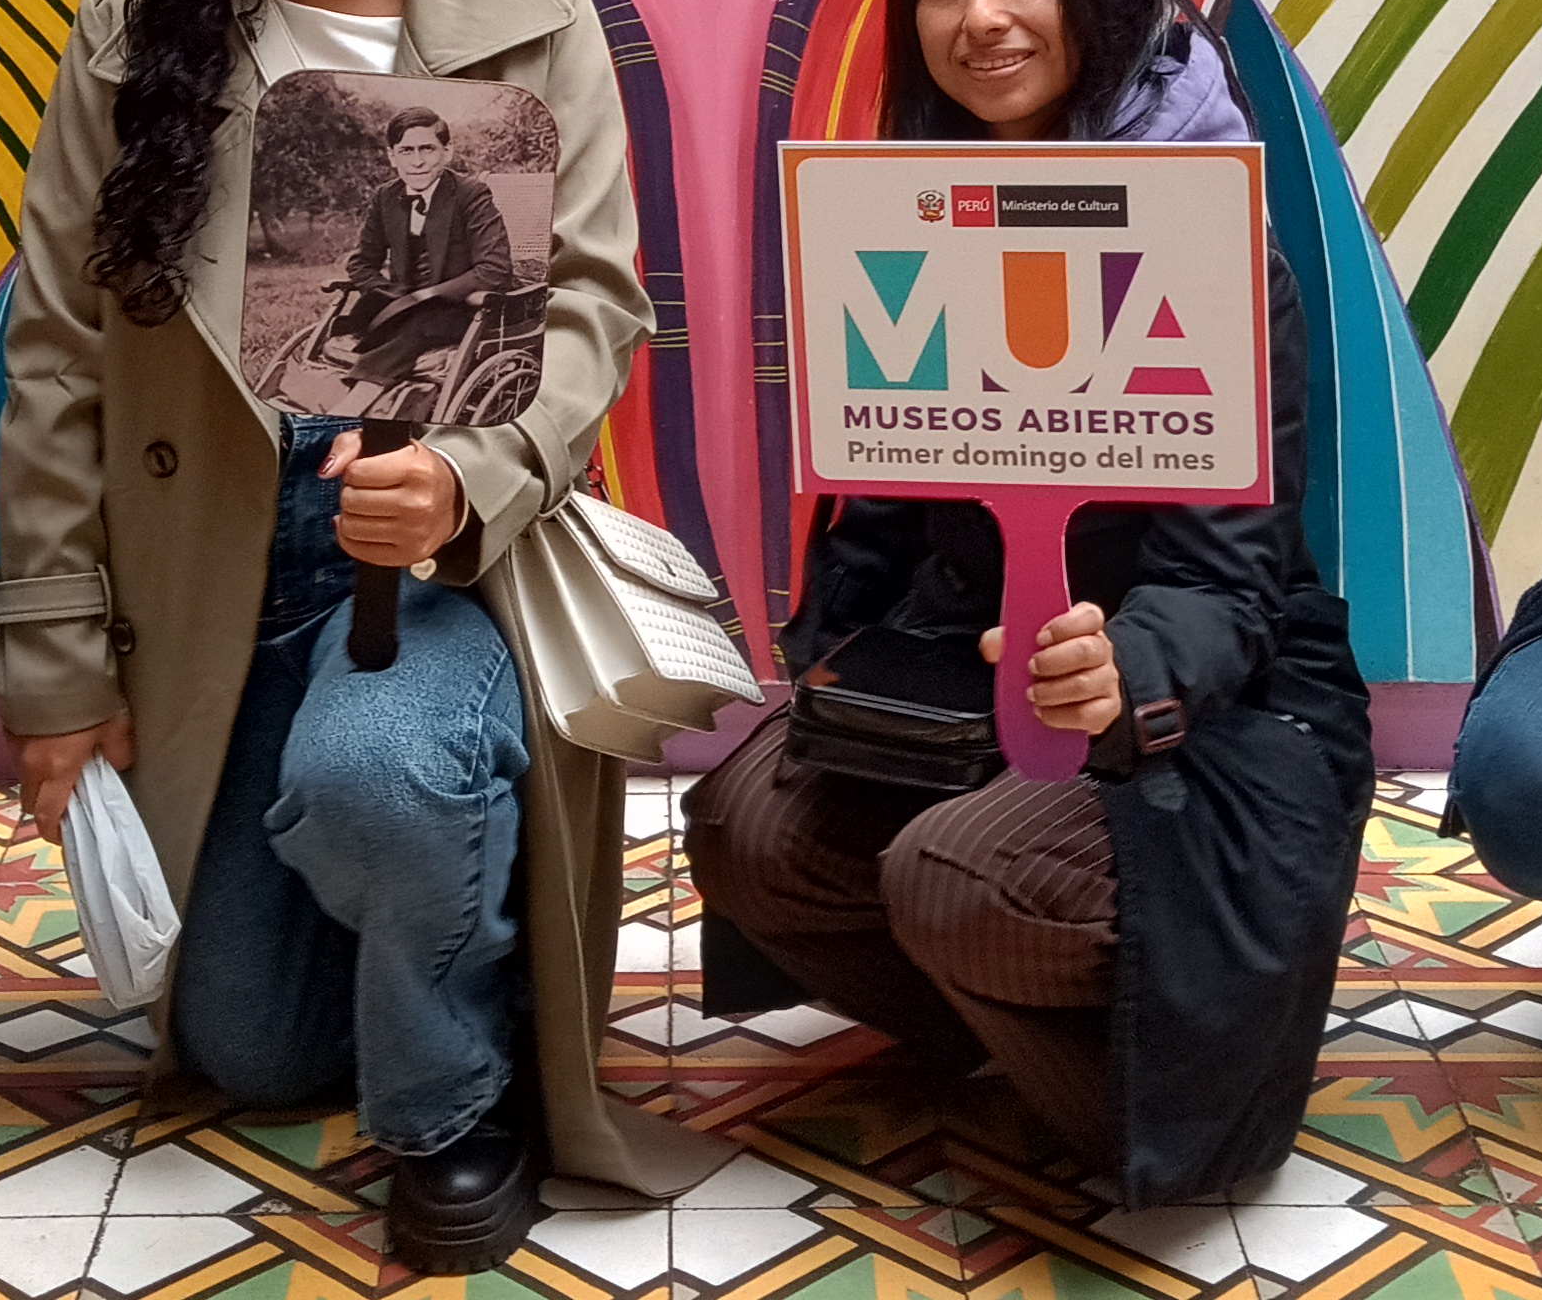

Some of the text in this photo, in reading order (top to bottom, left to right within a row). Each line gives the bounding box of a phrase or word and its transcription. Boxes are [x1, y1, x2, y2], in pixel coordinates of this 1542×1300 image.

[957, 196, 991, 213] PERÚ
[1001, 199, 1120, 213] Ministerio de Cultura
[843, 250, 1215, 397] MUA
[843, 405, 1214, 436] MUSEOS ABIERTOS
[847, 440, 1215, 474] Primer domingo del mes
